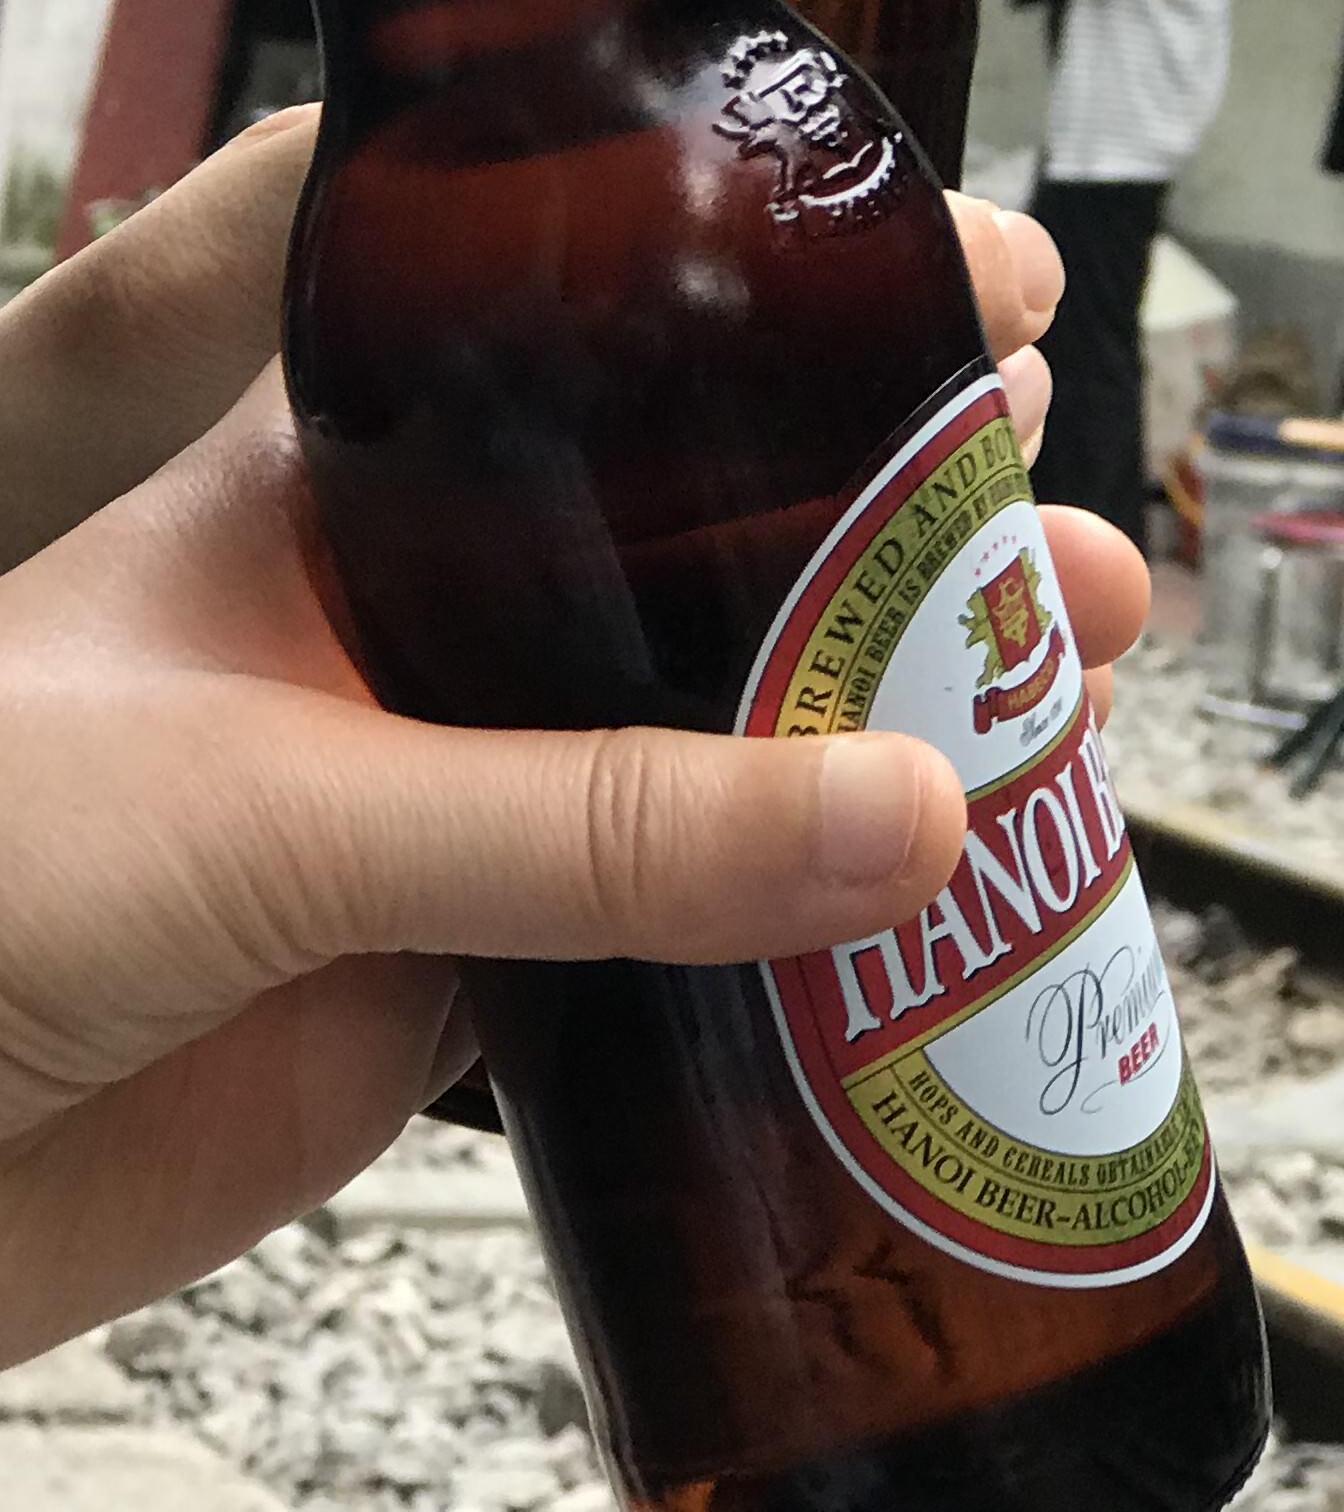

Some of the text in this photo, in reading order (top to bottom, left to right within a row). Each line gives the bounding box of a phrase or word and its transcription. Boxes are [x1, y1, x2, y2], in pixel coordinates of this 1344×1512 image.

[911, 452, 977, 539] AND
[866, 607, 906, 663] BEER
[897, 578, 922, 607] IS
[832, 761, 1103, 1043] HANOI
[1118, 1021, 1160, 1086] BEER
[871, 1089, 978, 1195] HANOI
[909, 1069, 959, 1125] HOPS
[955, 1120, 1000, 1159] AND
[1003, 1145, 1091, 1187] CEREALS
